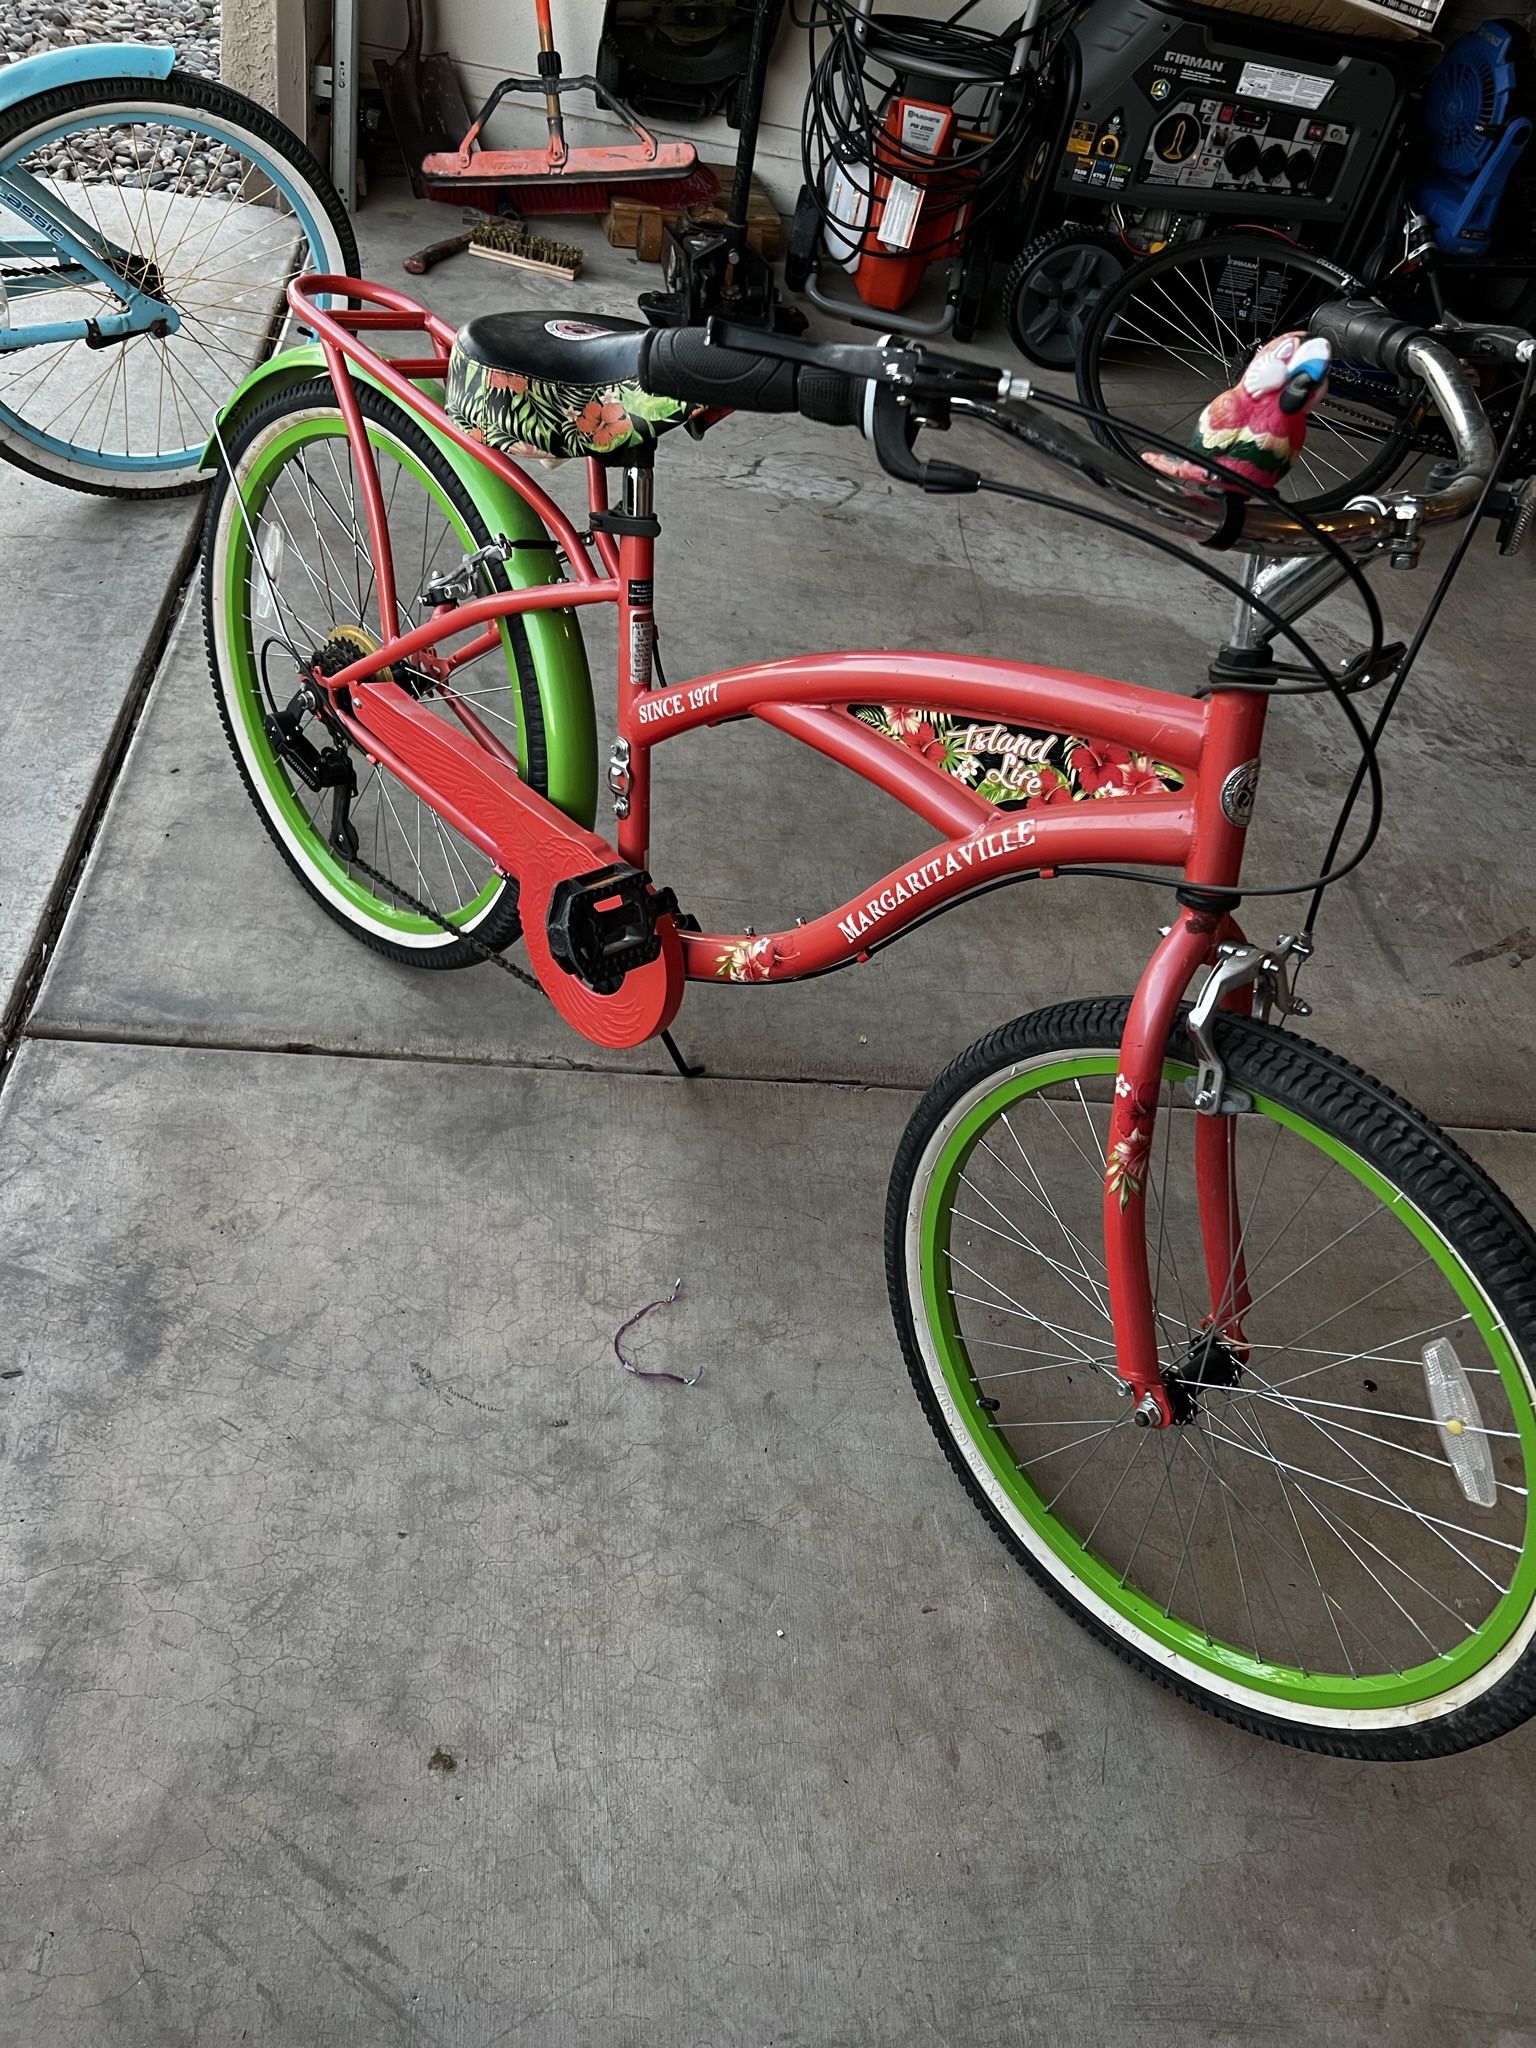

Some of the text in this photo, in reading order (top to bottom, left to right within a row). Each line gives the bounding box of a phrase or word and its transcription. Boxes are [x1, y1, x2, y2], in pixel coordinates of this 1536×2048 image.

[1164, 51, 1224, 72] FIRMAN
[638, 682, 719, 725] SINCE 1977
[945, 723, 1059, 765] Island
[985, 752, 1042, 796] Life
[837, 818, 1036, 944] MARGARITAVILLE
